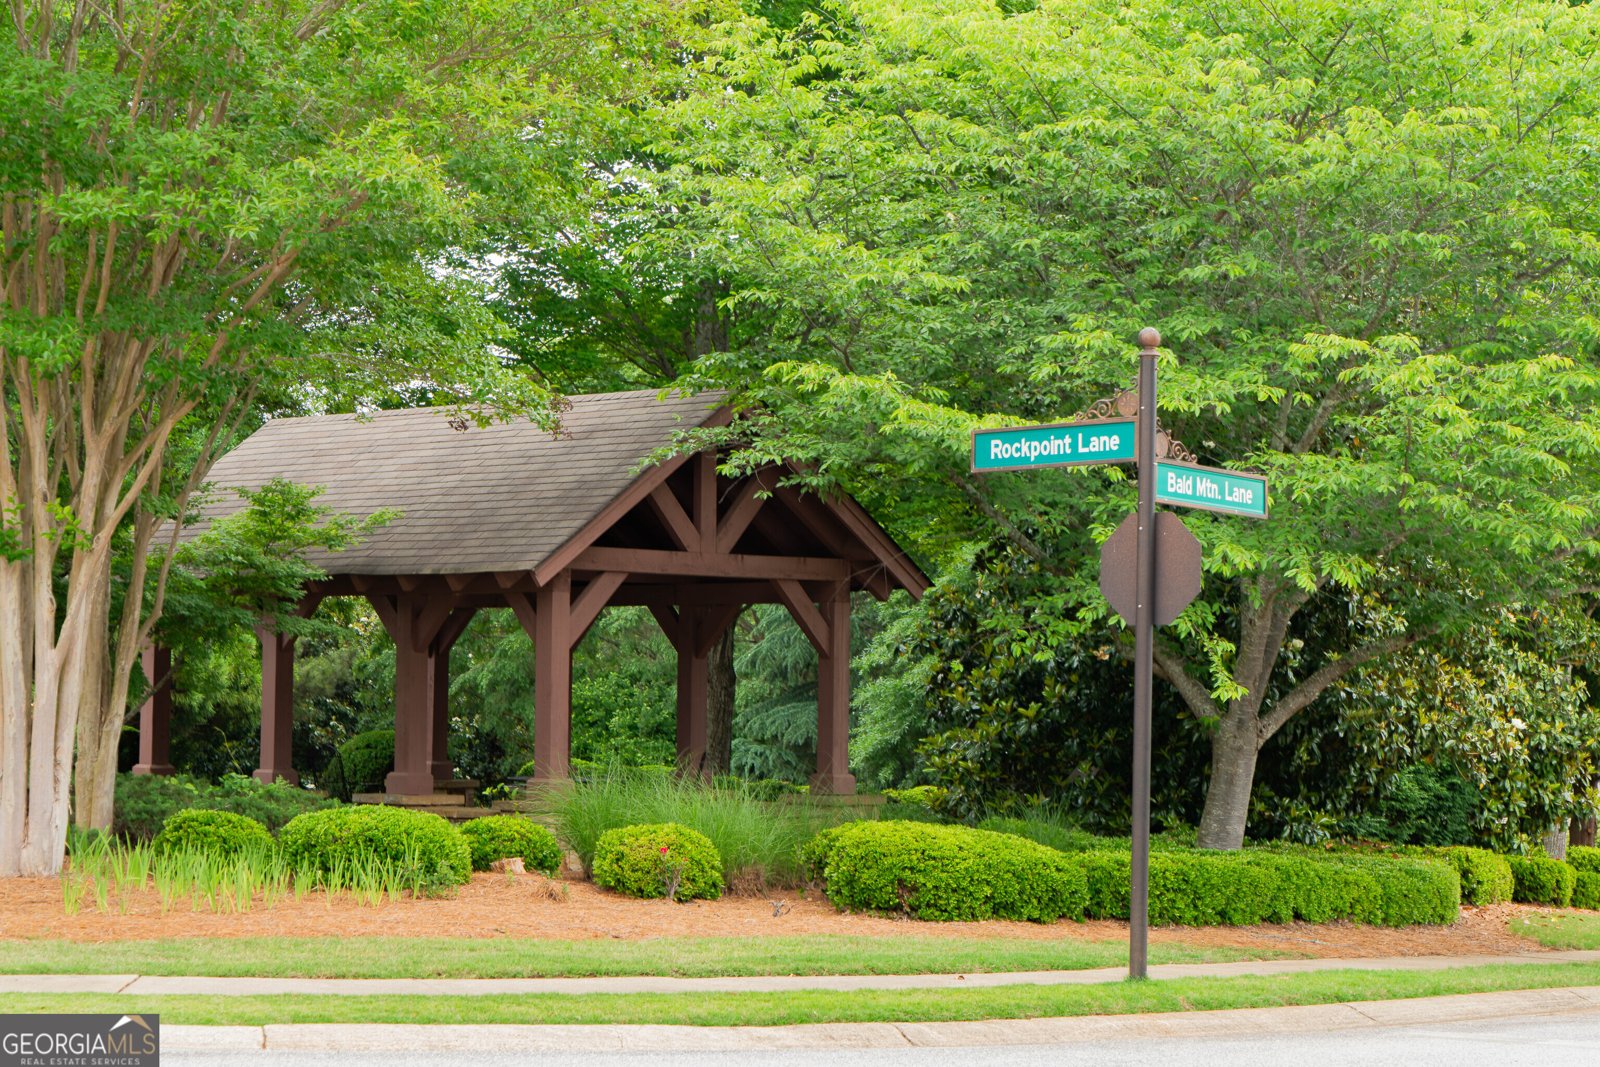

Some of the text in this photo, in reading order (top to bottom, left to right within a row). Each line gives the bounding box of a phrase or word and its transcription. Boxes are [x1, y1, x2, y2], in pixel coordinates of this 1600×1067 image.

[990, 432, 1120, 461] Rockpoint Lane
[1167, 472, 1253, 504] Bald Mtn. Lane
